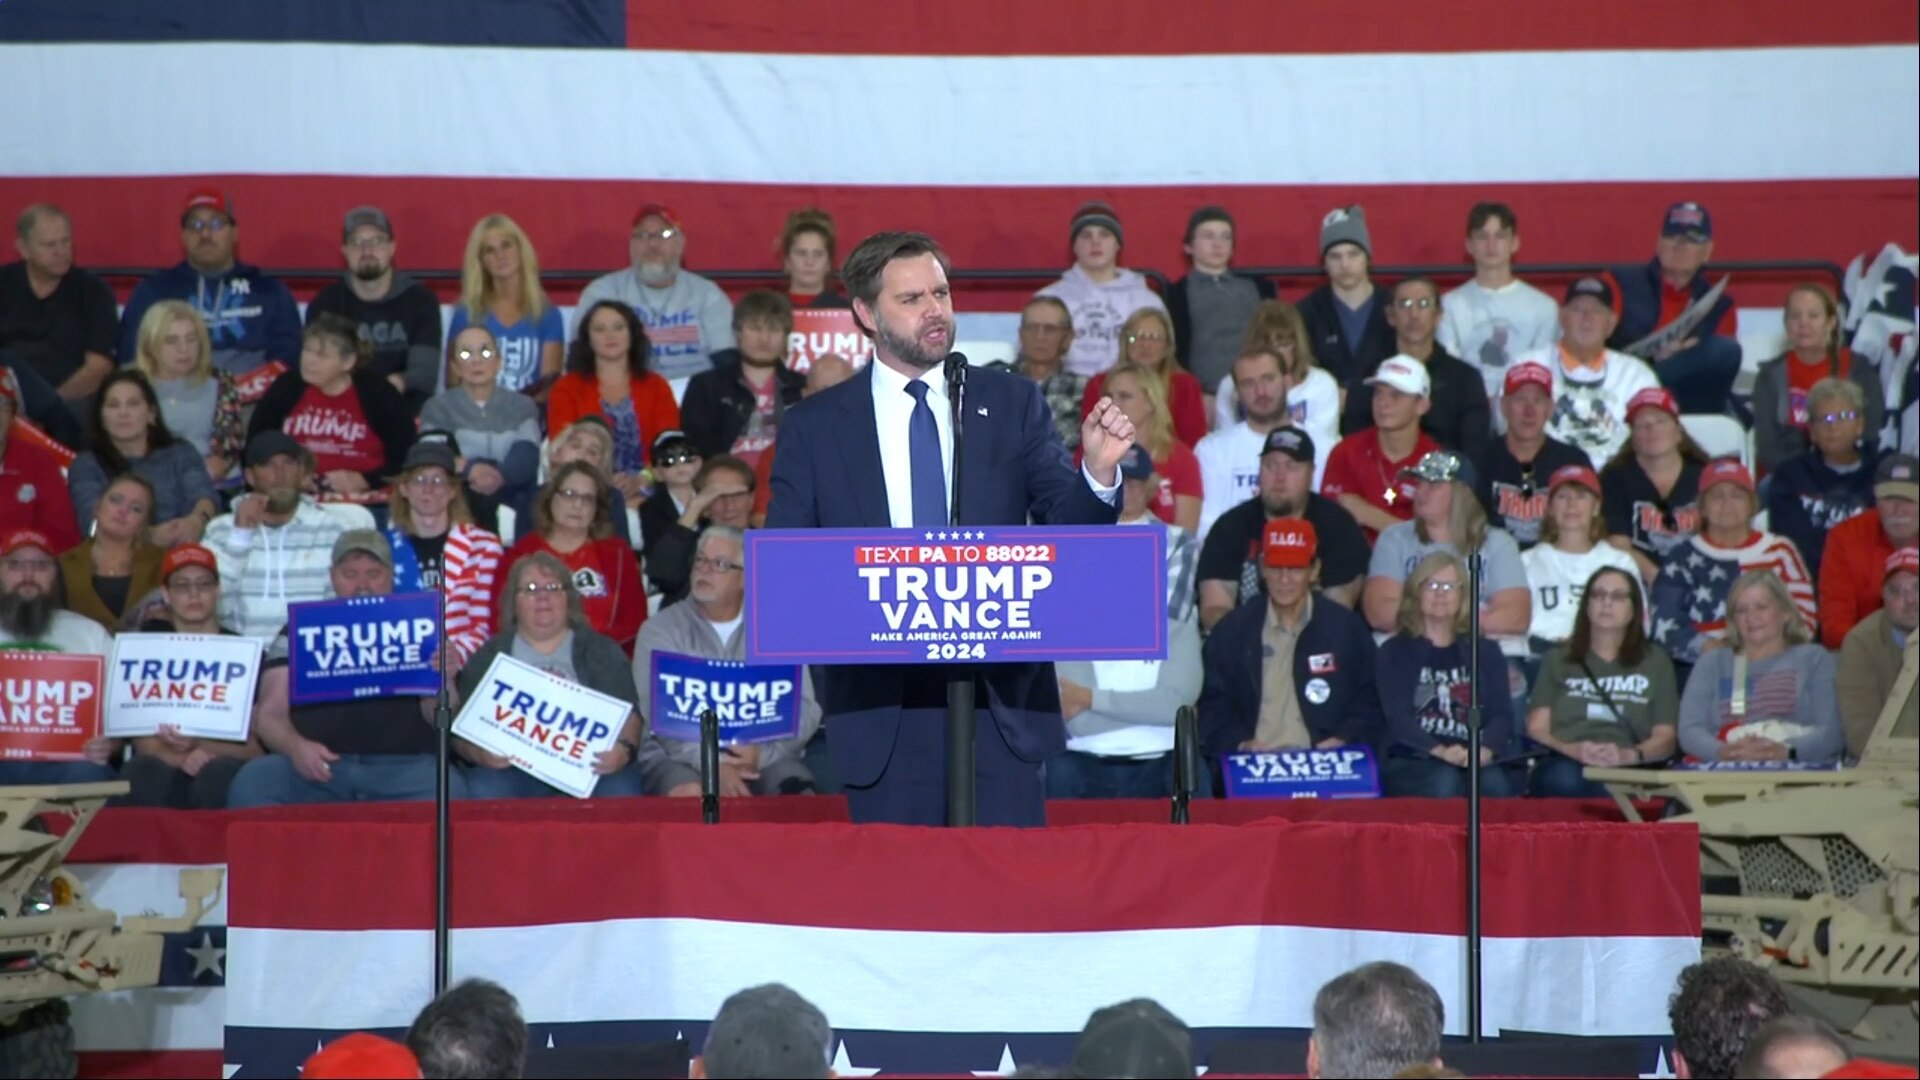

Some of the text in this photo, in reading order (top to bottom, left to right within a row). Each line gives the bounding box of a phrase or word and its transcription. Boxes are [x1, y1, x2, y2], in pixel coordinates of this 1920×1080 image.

[787, 332, 874, 353] RUMP
[861, 545, 1050, 563] TEXT PA TO 88022
[858, 565, 1053, 601] TRUMP
[880, 601, 1031, 630] VANCE
[297, 618, 436, 652] TRUMP
[871, 630, 1041, 641] MAKE AMERICA GREAT AGAIN!
[314, 644, 421, 670] VANCE
[926, 643, 986, 659] 2024
[120, 659, 247, 684] TRUMP
[0, 679, 94, 705] UMP
[130, 682, 228, 703] VANCE
[659, 673, 794, 704] TRUMP
[492, 679, 609, 742] TRUMP
[674, 696, 777, 721] VANCE
[494, 704, 588, 760] VANCE
[1228, 751, 1365, 766] TRUMP
[1247, 763, 1354, 777] VANCE
